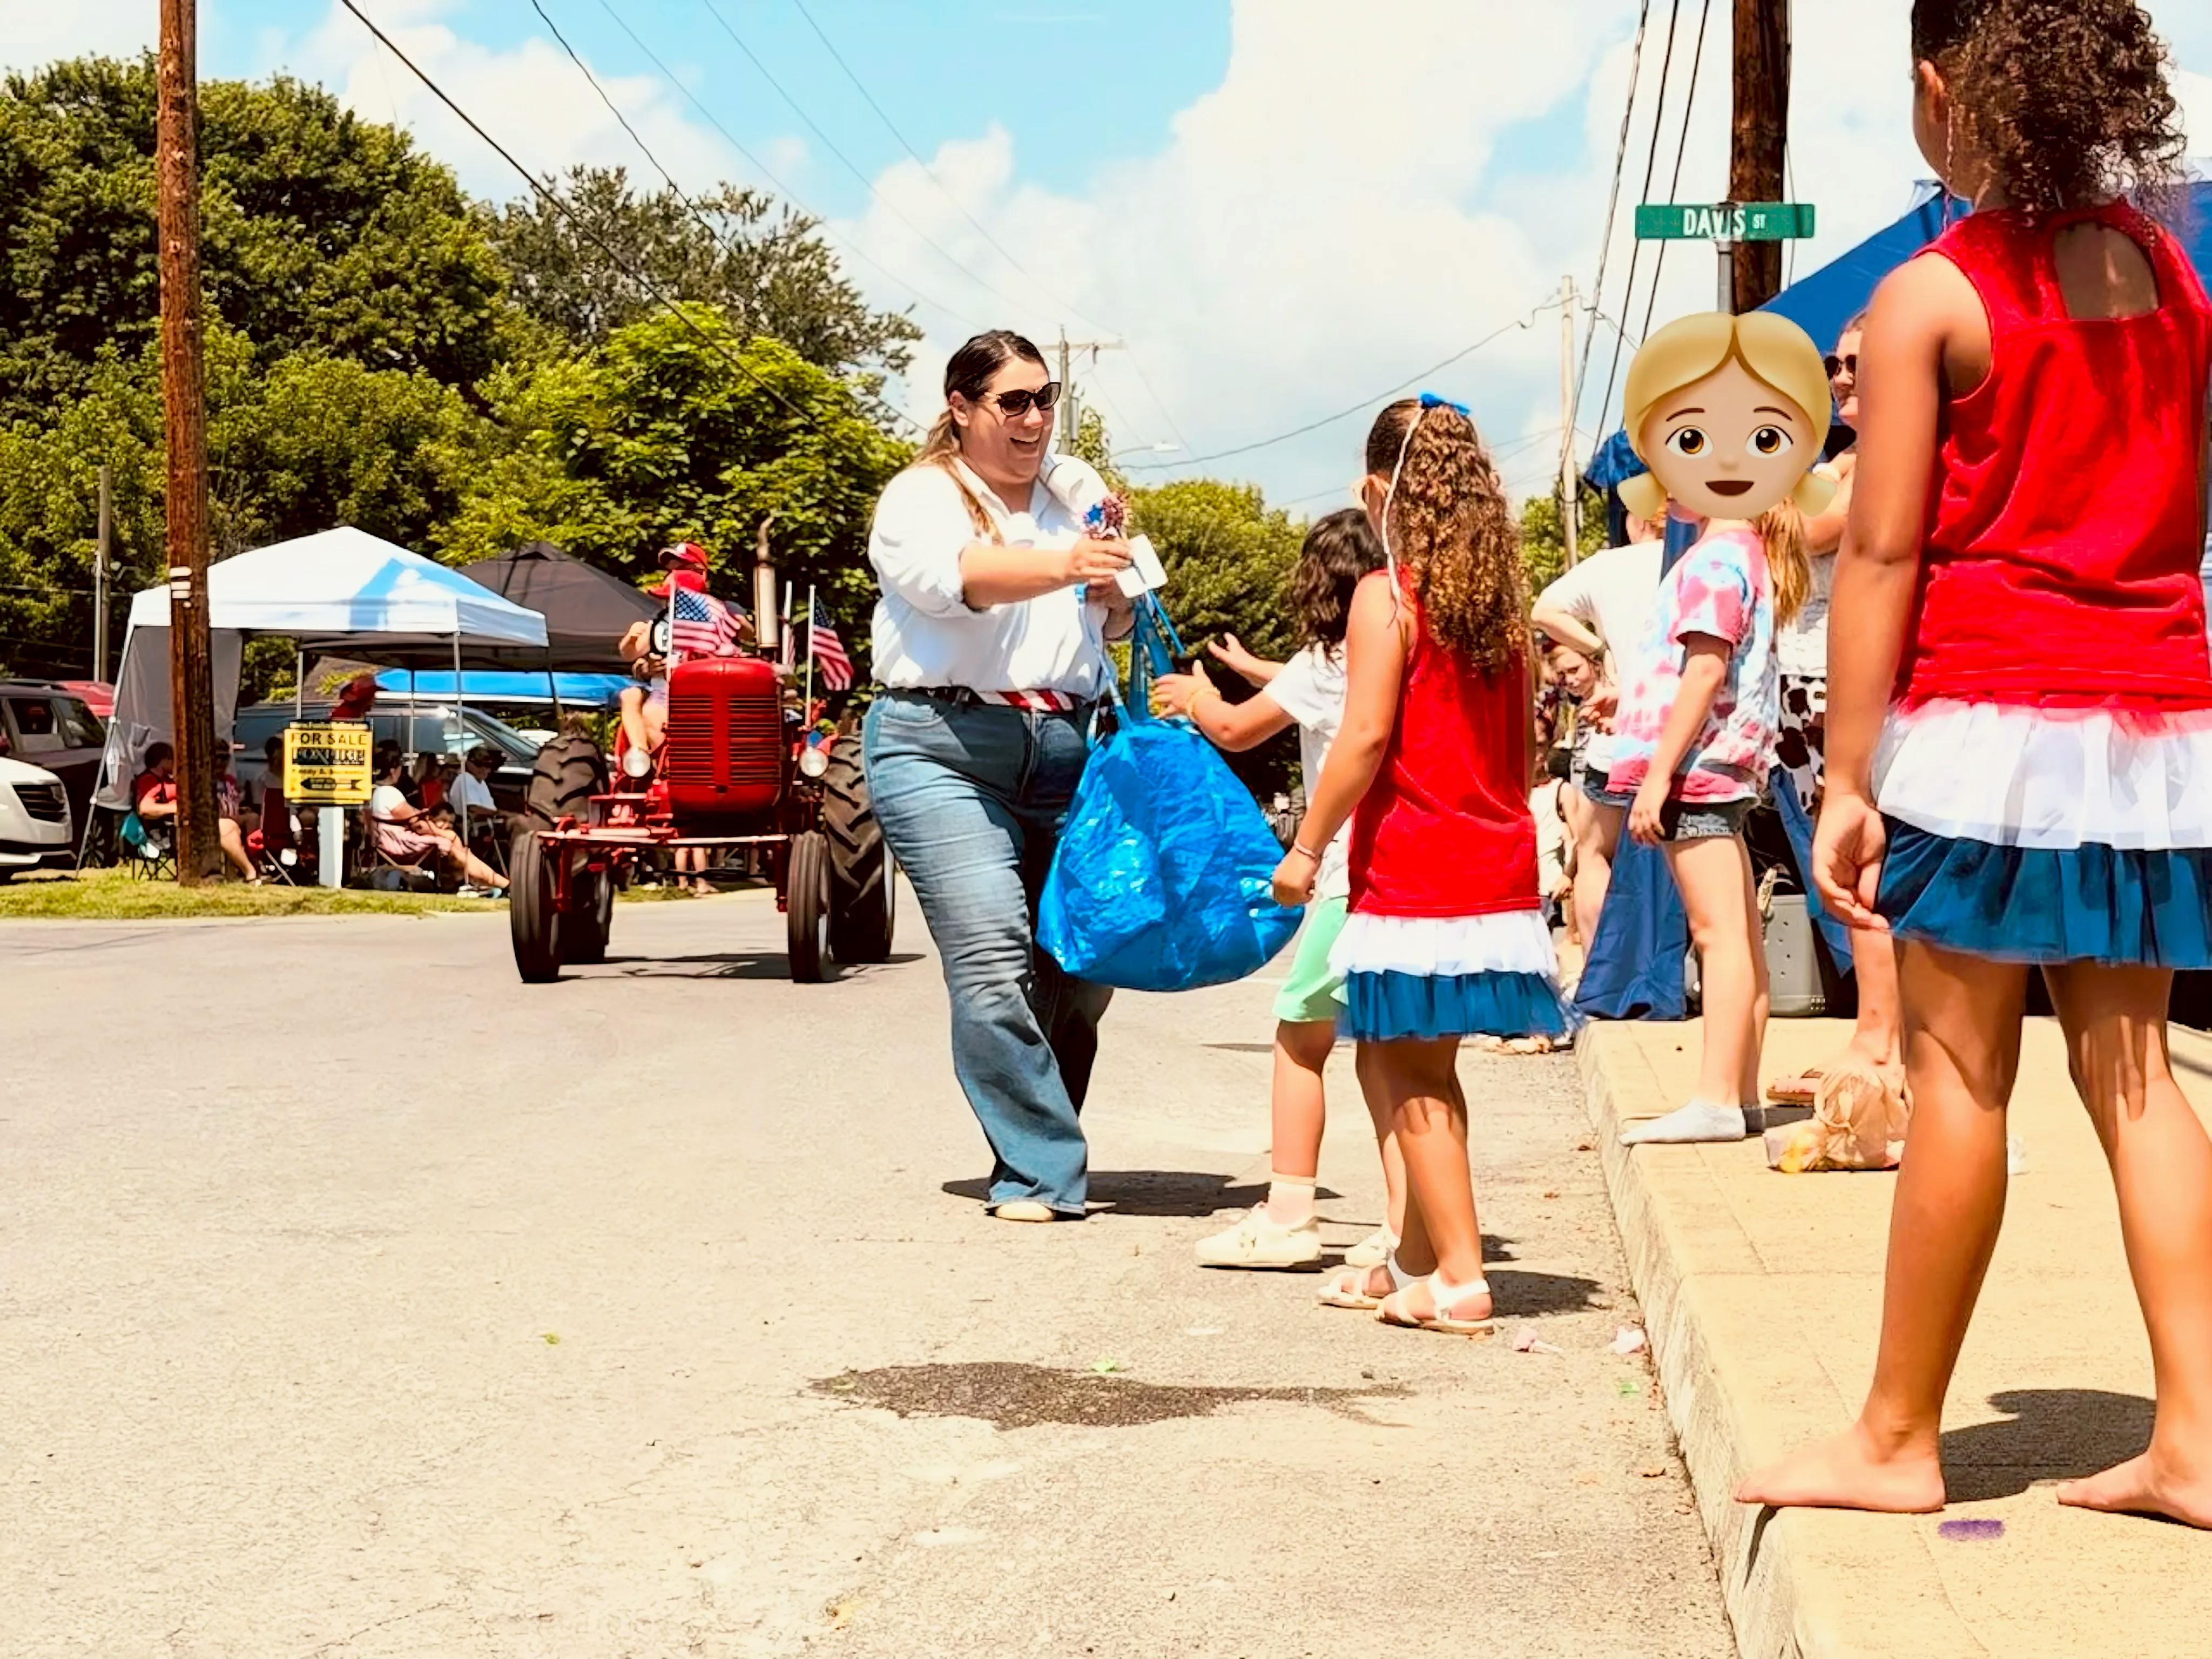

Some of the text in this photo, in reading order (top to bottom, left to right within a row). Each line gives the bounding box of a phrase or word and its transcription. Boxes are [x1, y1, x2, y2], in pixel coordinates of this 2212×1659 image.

[1683, 208, 1766, 237] DAVIS ST
[292, 732, 367, 745] FOR SALE
